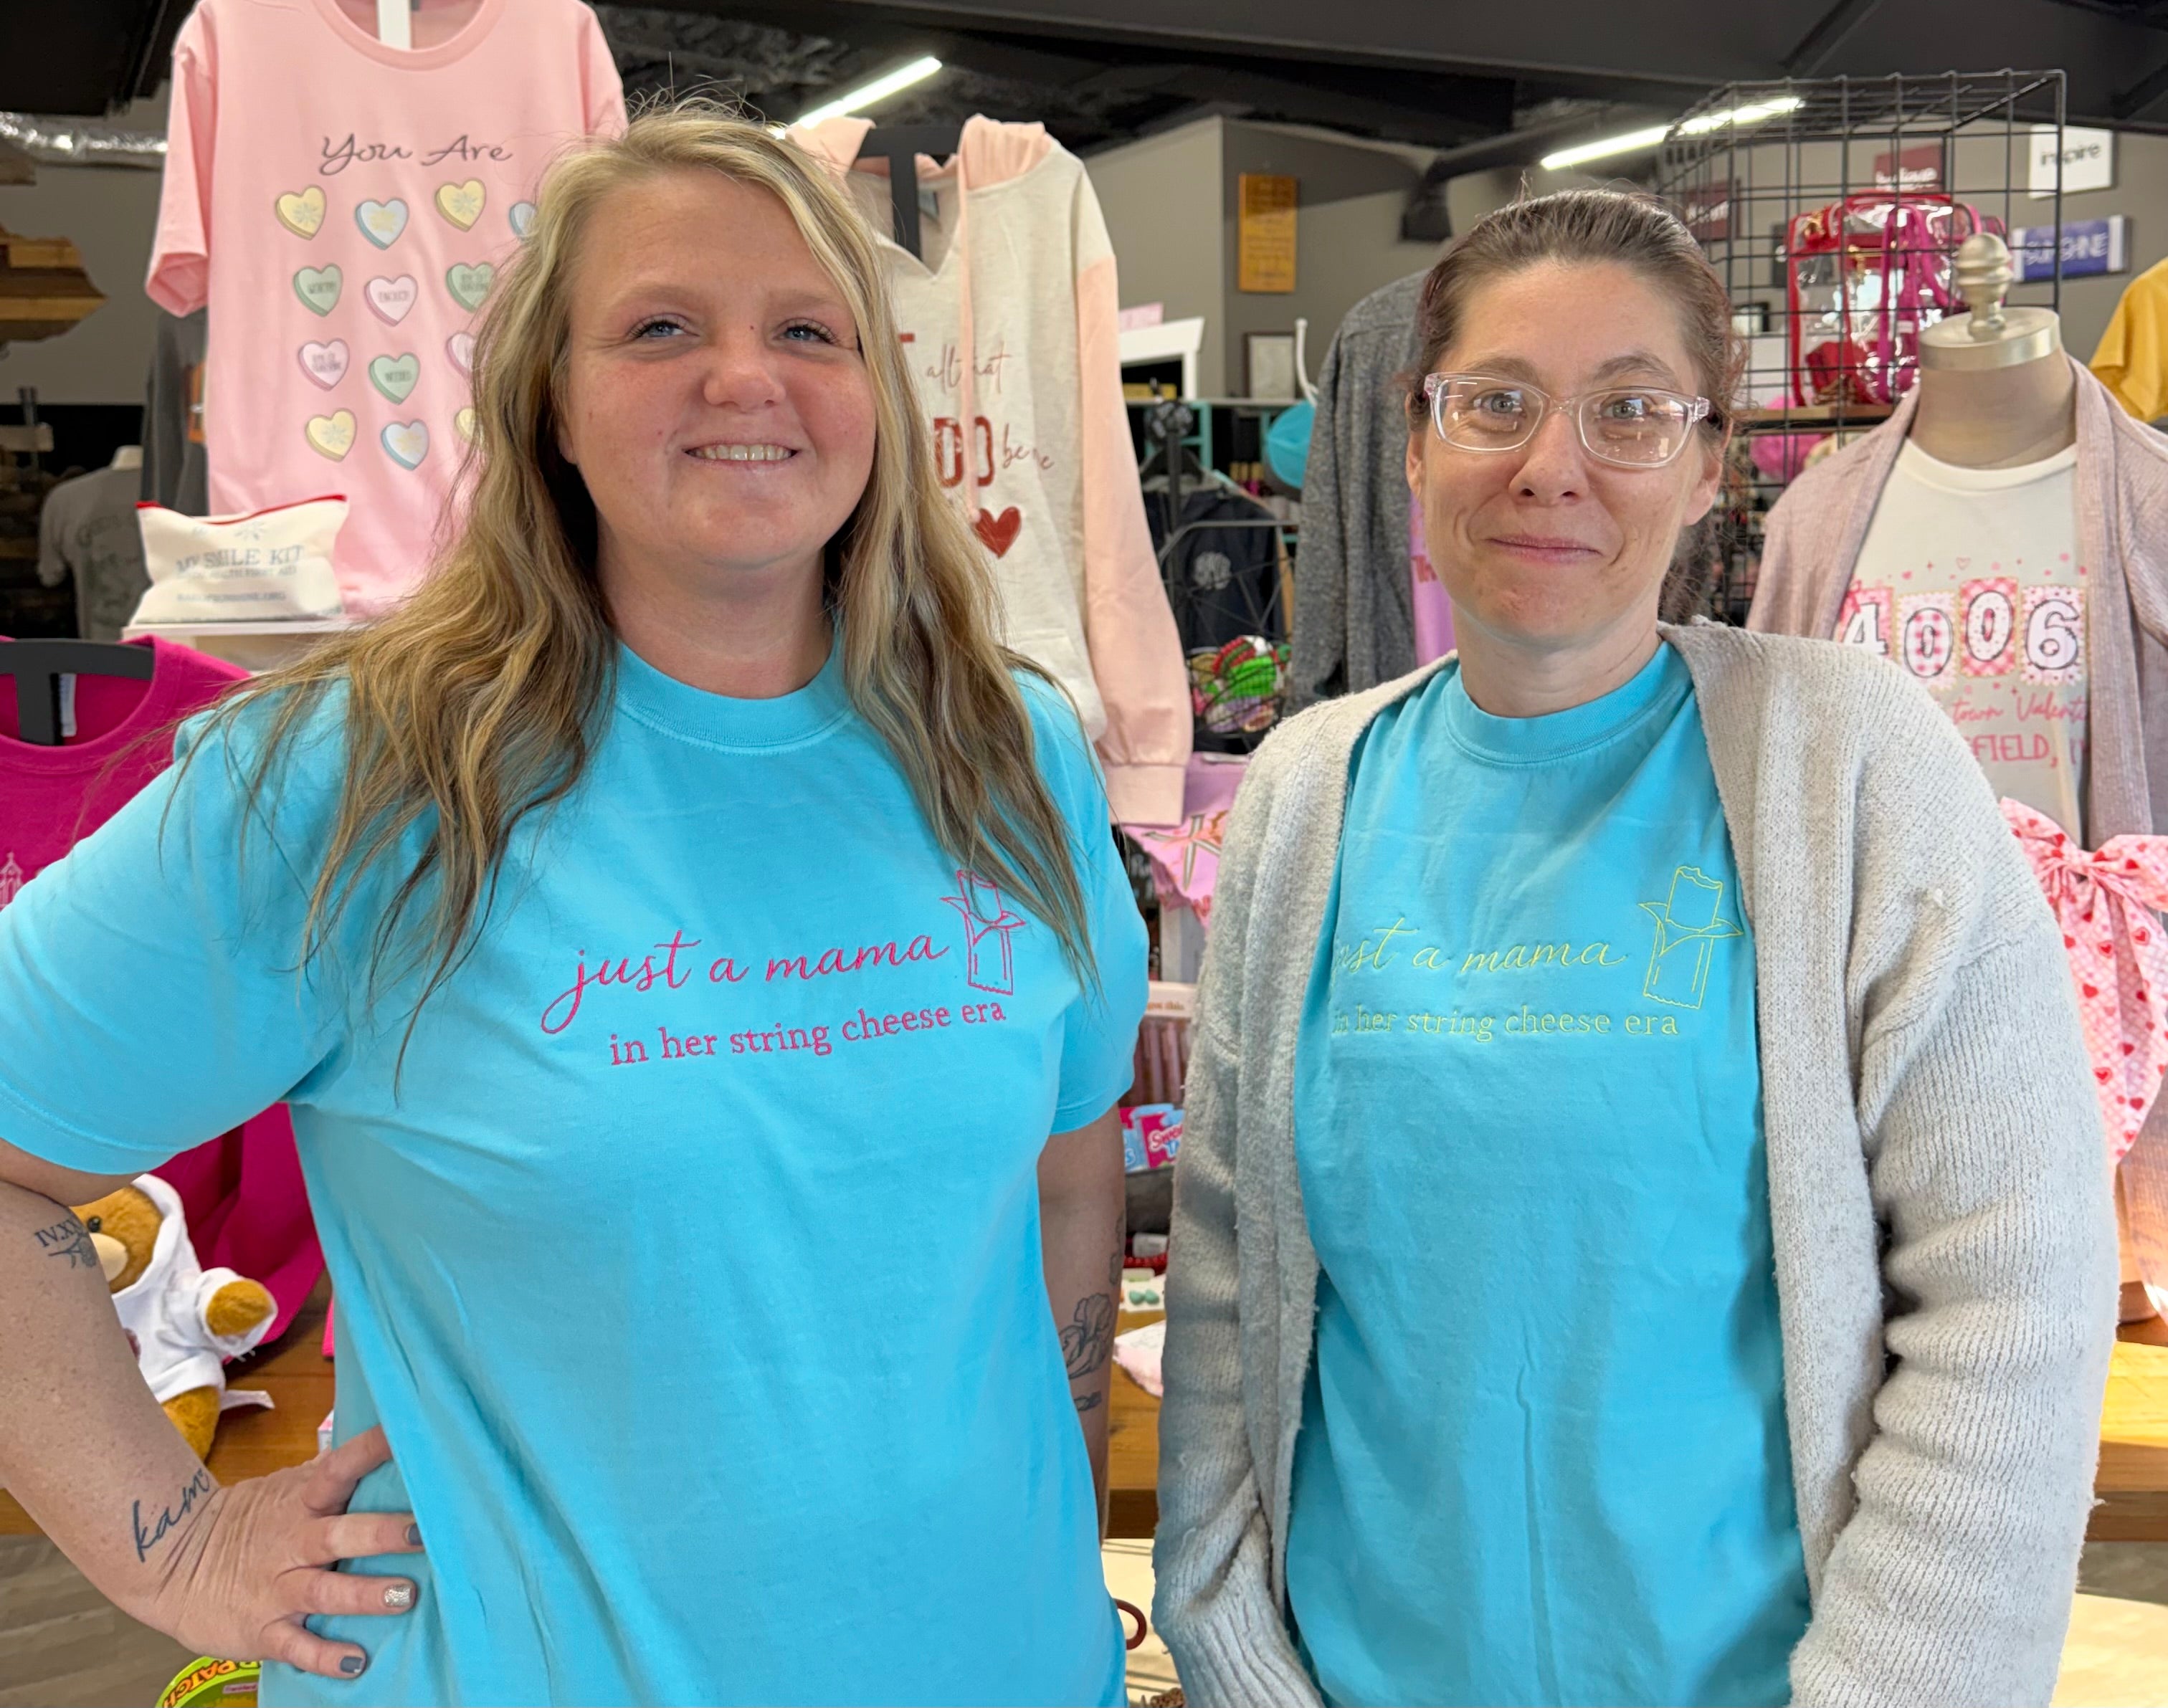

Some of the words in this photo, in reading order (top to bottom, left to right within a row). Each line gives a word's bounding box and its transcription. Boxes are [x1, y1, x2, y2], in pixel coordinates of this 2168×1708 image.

[319, 133, 413, 176] You
[421, 134, 513, 166] Are
[2041, 143, 2101, 166] inpire
[270, 544, 305, 566] KIT
[1841, 589, 2079, 678] 4006
[1412, 945, 1452, 970] a
[1460, 939, 1630, 974] mama
[541, 930, 702, 1034] just
[709, 956, 749, 983] a
[765, 933, 951, 982] mama
[610, 1034, 649, 1066] in
[659, 1026, 717, 1059] her
[730, 1021, 833, 1056] string
[842, 1001, 951, 1042] cheese
[961, 1001, 1007, 1024] era
[1354, 1003, 1397, 1032] her
[1406, 1008, 1496, 1042] string
[1504, 1005, 1612, 1036] cheese
[1625, 1011, 1679, 1036] era
